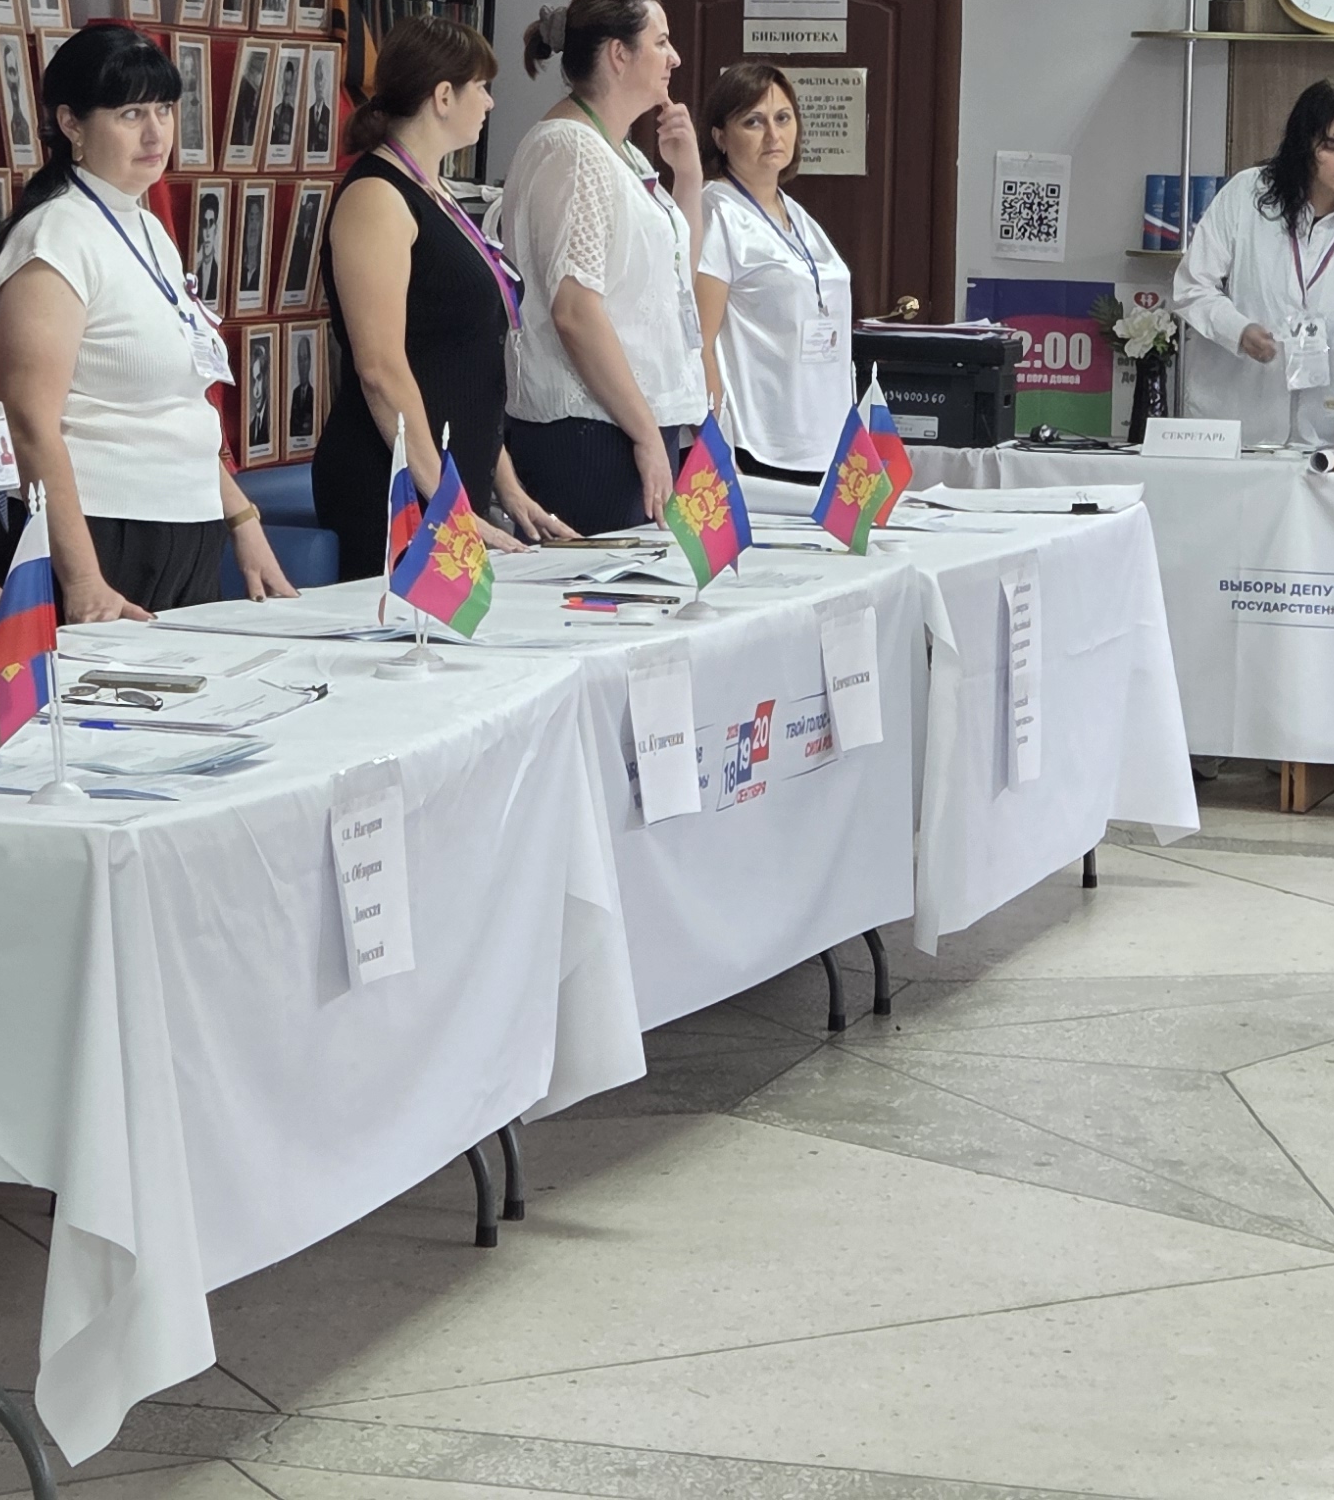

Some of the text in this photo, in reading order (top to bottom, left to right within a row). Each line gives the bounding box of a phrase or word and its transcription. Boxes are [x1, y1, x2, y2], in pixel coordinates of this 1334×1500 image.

[752, 31, 838, 42] БИБЛИОТЕКА
[798, 76, 839, 86] ФИЛИАЛ
[852, 77, 861, 86] 13
[811, 121, 841, 129] РАБОТА
[1026, 373, 1048, 384] ПОРА
[1049, 373, 1080, 386] ДОМОЙ
[1161, 431, 1225, 442] СЕКРЕТАРЬ
[1219, 579, 1286, 594] ВЫБОРЫ
[752, 715, 768, 750] 20
[786, 715, 806, 740] ТВОЙ
[739, 737, 751, 771] 19
[724, 760, 736, 795] 18
